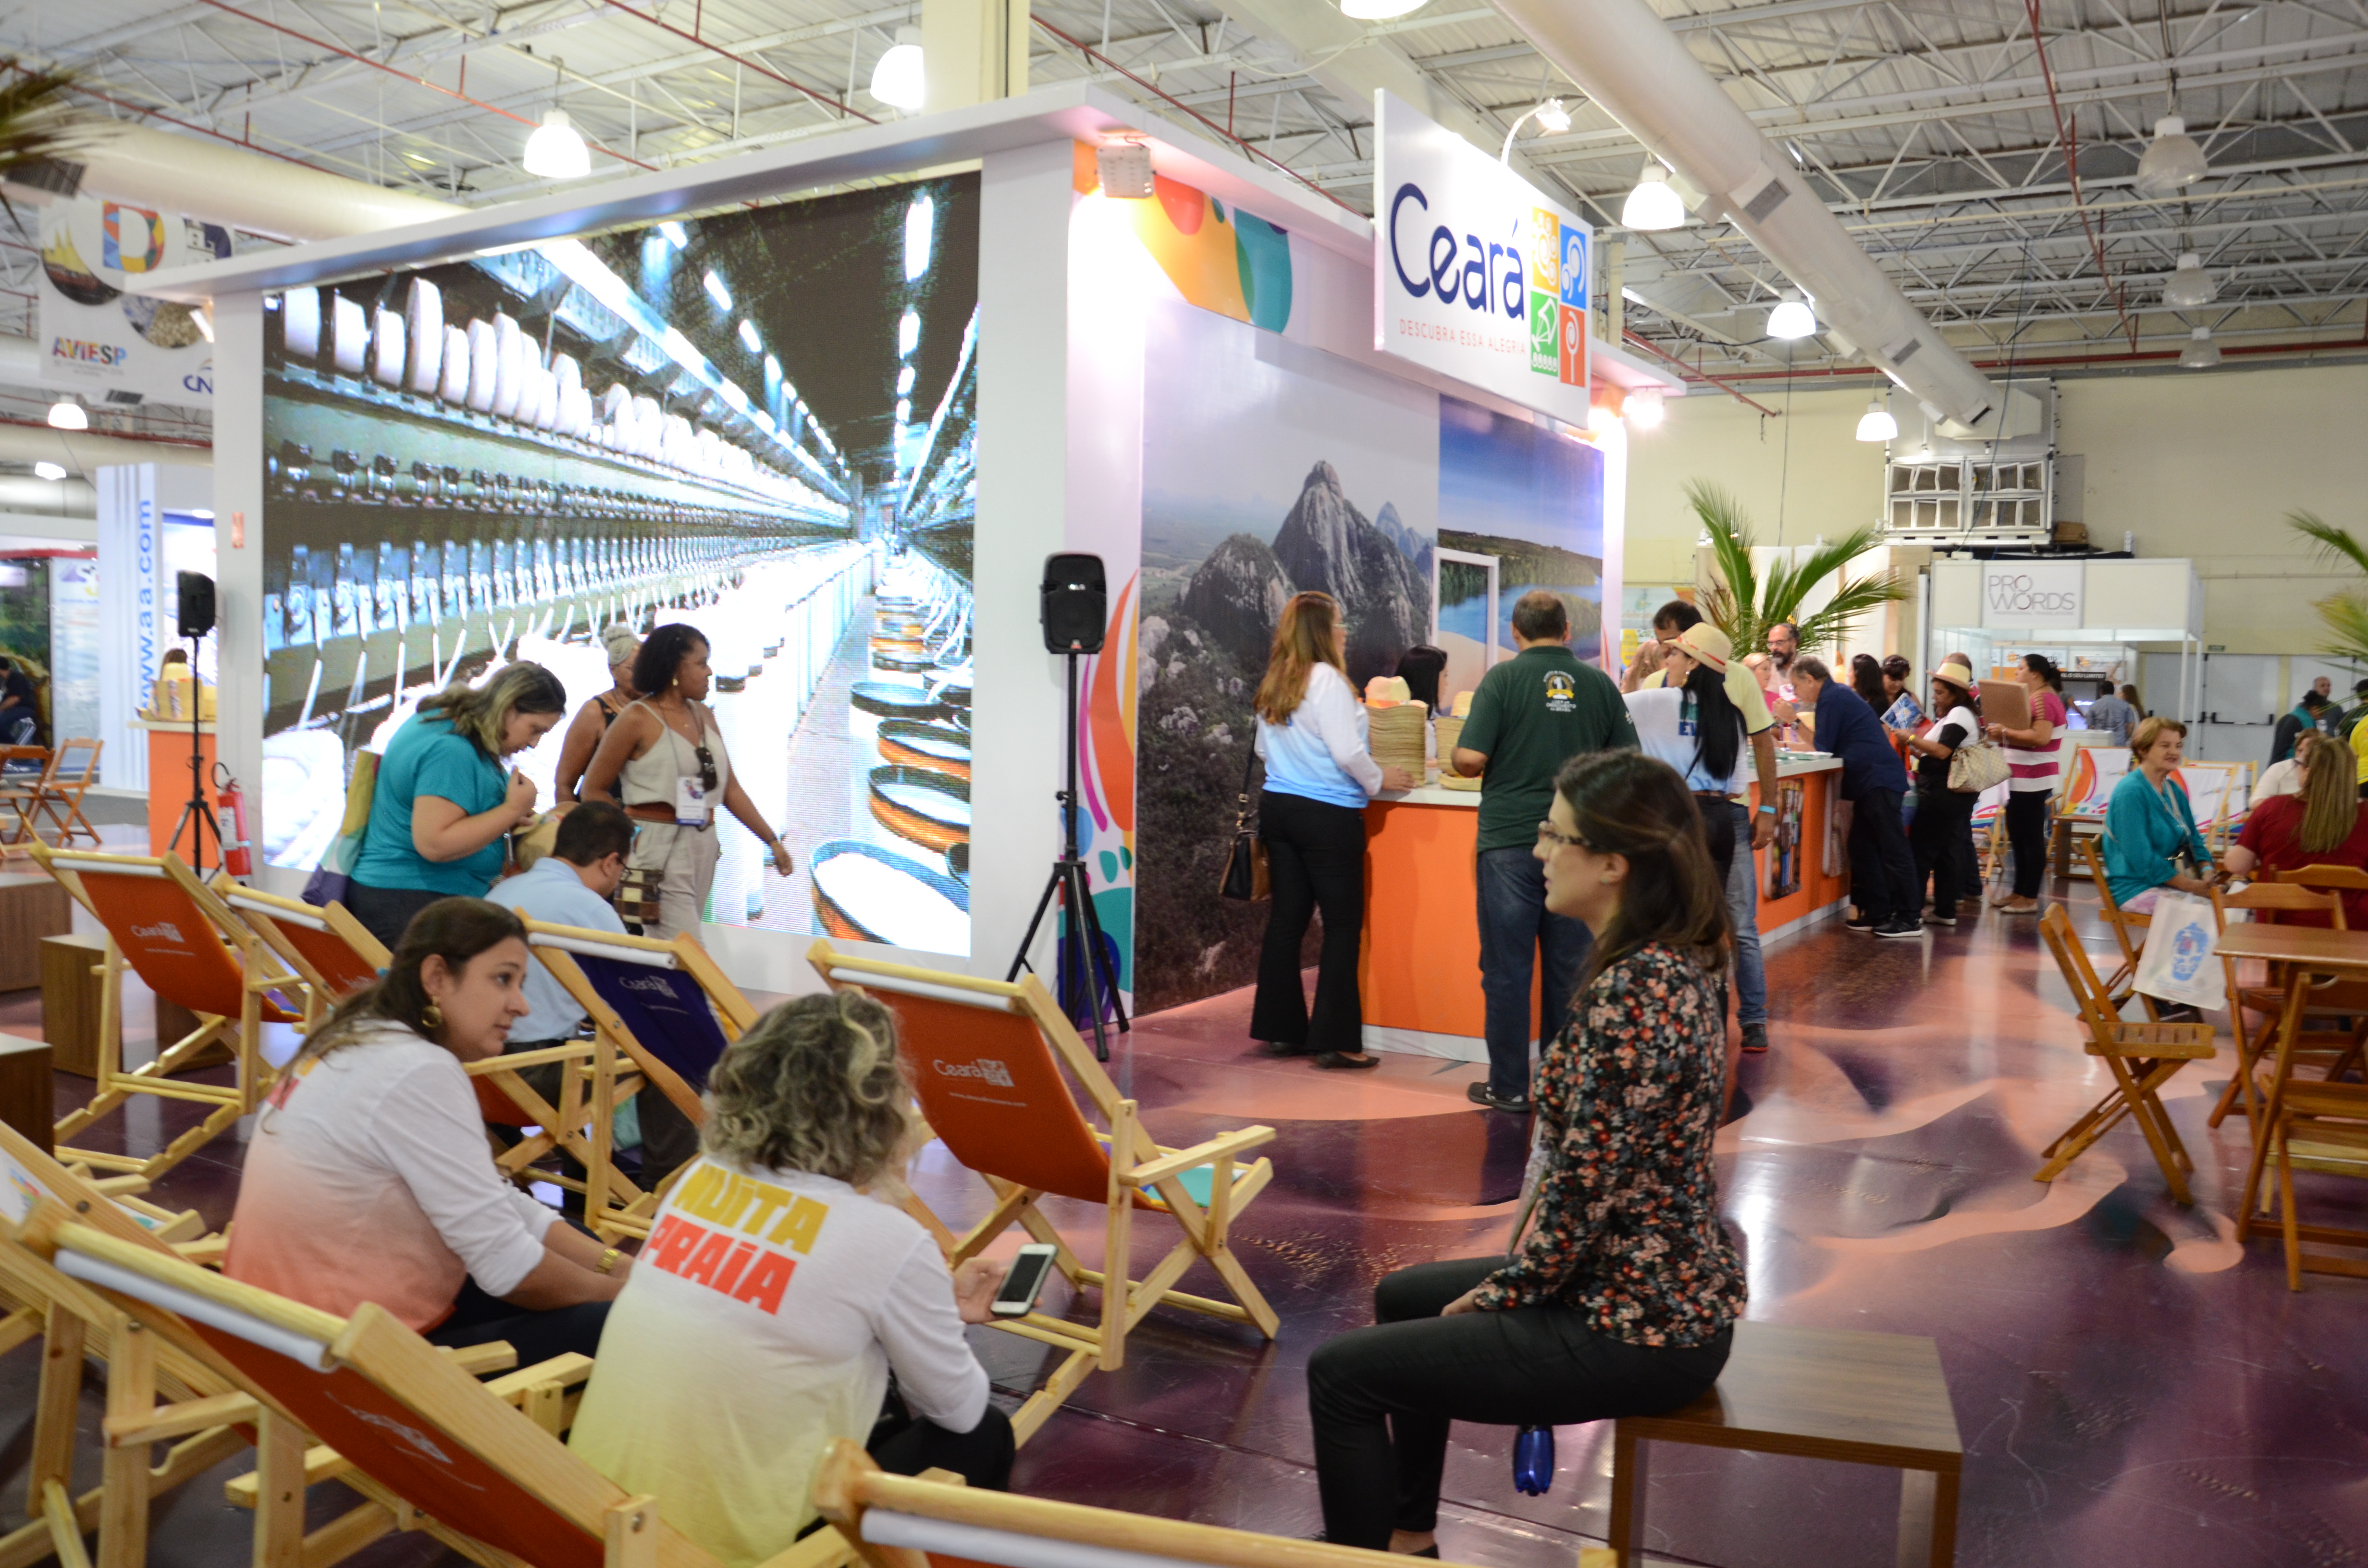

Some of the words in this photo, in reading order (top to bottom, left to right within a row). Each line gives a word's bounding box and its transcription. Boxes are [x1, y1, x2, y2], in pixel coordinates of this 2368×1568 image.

[1390, 183, 1524, 321] Ceará
[51, 336, 127, 366] AVIESP
[1400, 318, 1455, 343] DESCUBRA
[1460, 330, 1483, 347] ESSA
[1488, 338, 1526, 355] ALEGRIA
[1988, 575, 2033, 592] PRO
[1988, 593, 2075, 610] WORDS
